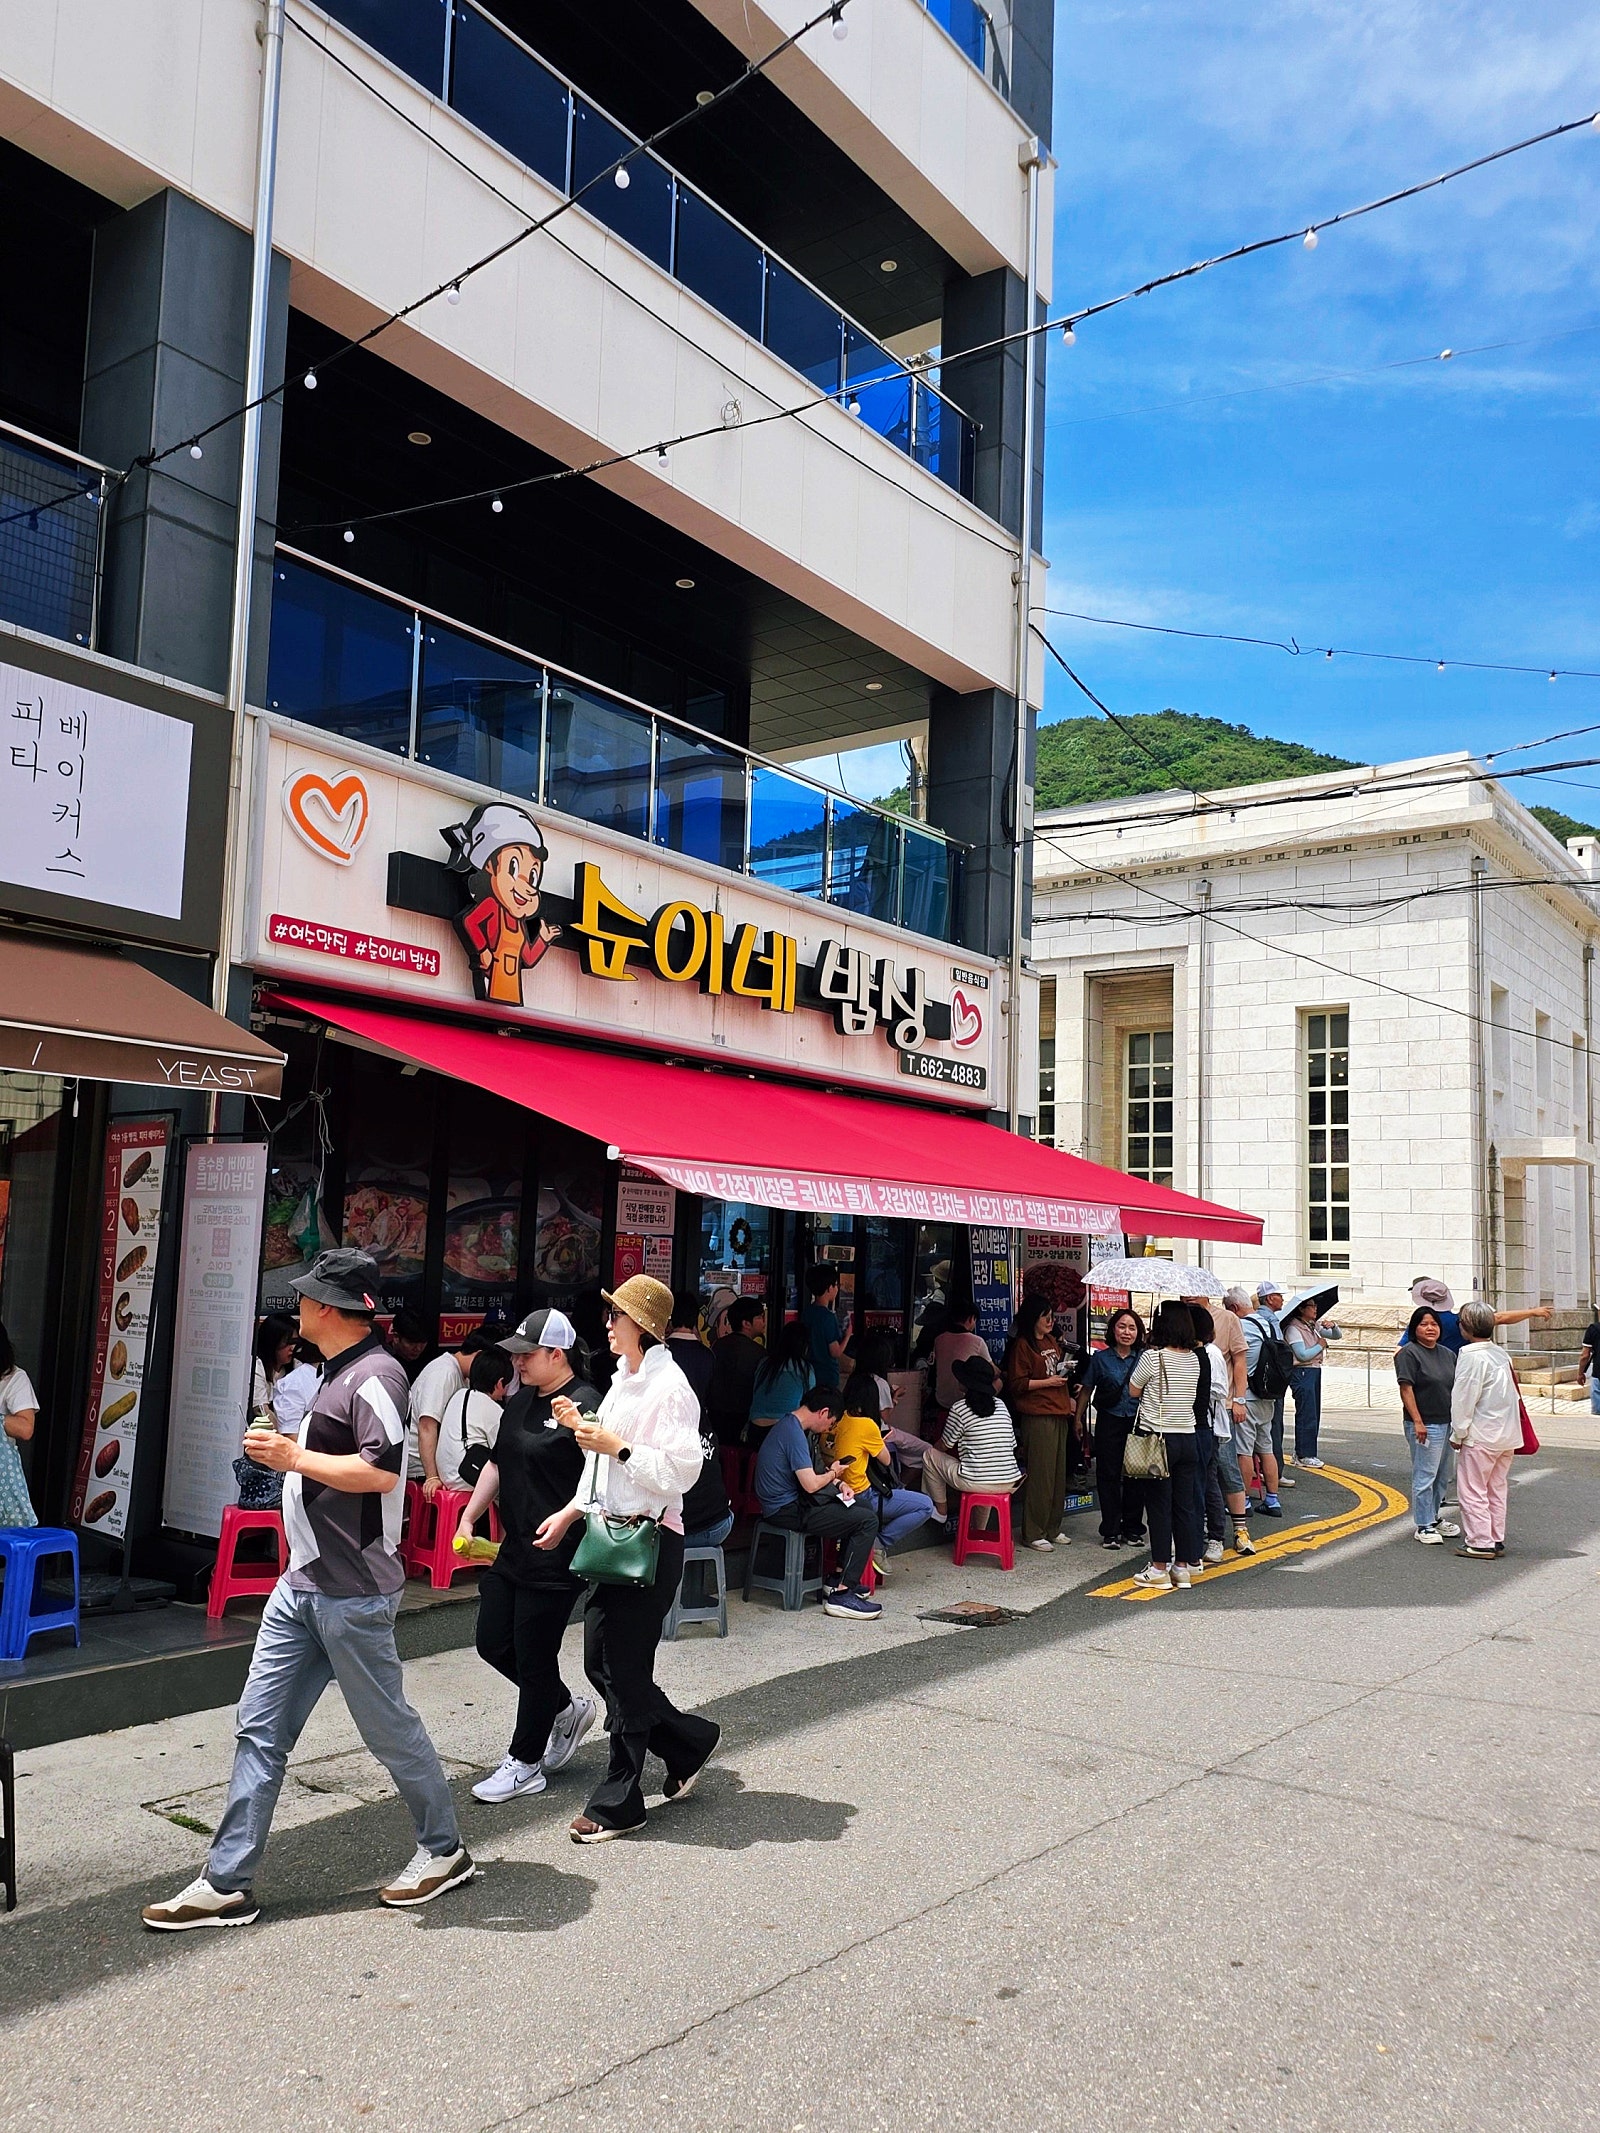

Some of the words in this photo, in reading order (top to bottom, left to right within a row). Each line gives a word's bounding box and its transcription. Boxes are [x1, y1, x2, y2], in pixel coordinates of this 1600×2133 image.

[273, 921, 348, 955] #여수맛집
[354, 939, 406, 964] #순이네
[409, 950, 438, 972] 밥상
[570, 860, 798, 1014] 순이네
[815, 939, 933, 1052] 밥상
[156, 1057, 258, 1088] YEAST
[906, 1054, 982, 1087] T.662-4883
[112, 1166, 117, 1188] 1
[716, 1173, 799, 1207] 간장게장은
[798, 1179, 844, 1209] 국내산
[843, 1182, 880, 1213] 돌게,
[878, 1185, 931, 1215] 갓김치와
[931, 1192, 969, 1219] 김치는
[969, 1196, 1003, 1221] 사오지
[1003, 1202, 1026, 1222] 않고
[1026, 1201, 1048, 1225] 직접
[1048, 1205, 1079, 1227] 담그고
[107, 1210, 115, 1231] 2
[616, 1237, 642, 1248] 금연구역
[972, 1229, 1008, 1254] 순이네밥상
[104, 1258, 112, 1279] 3
[454, 1296, 484, 1308] 갈치조림
[488, 1296, 503, 1308] 정식
[102, 1306, 108, 1327] 4
[96, 1353, 104, 1374] 5
[89, 1401, 96, 1422] 6
[82, 1450, 90, 1472] 7
[74, 1496, 82, 1518] 8
